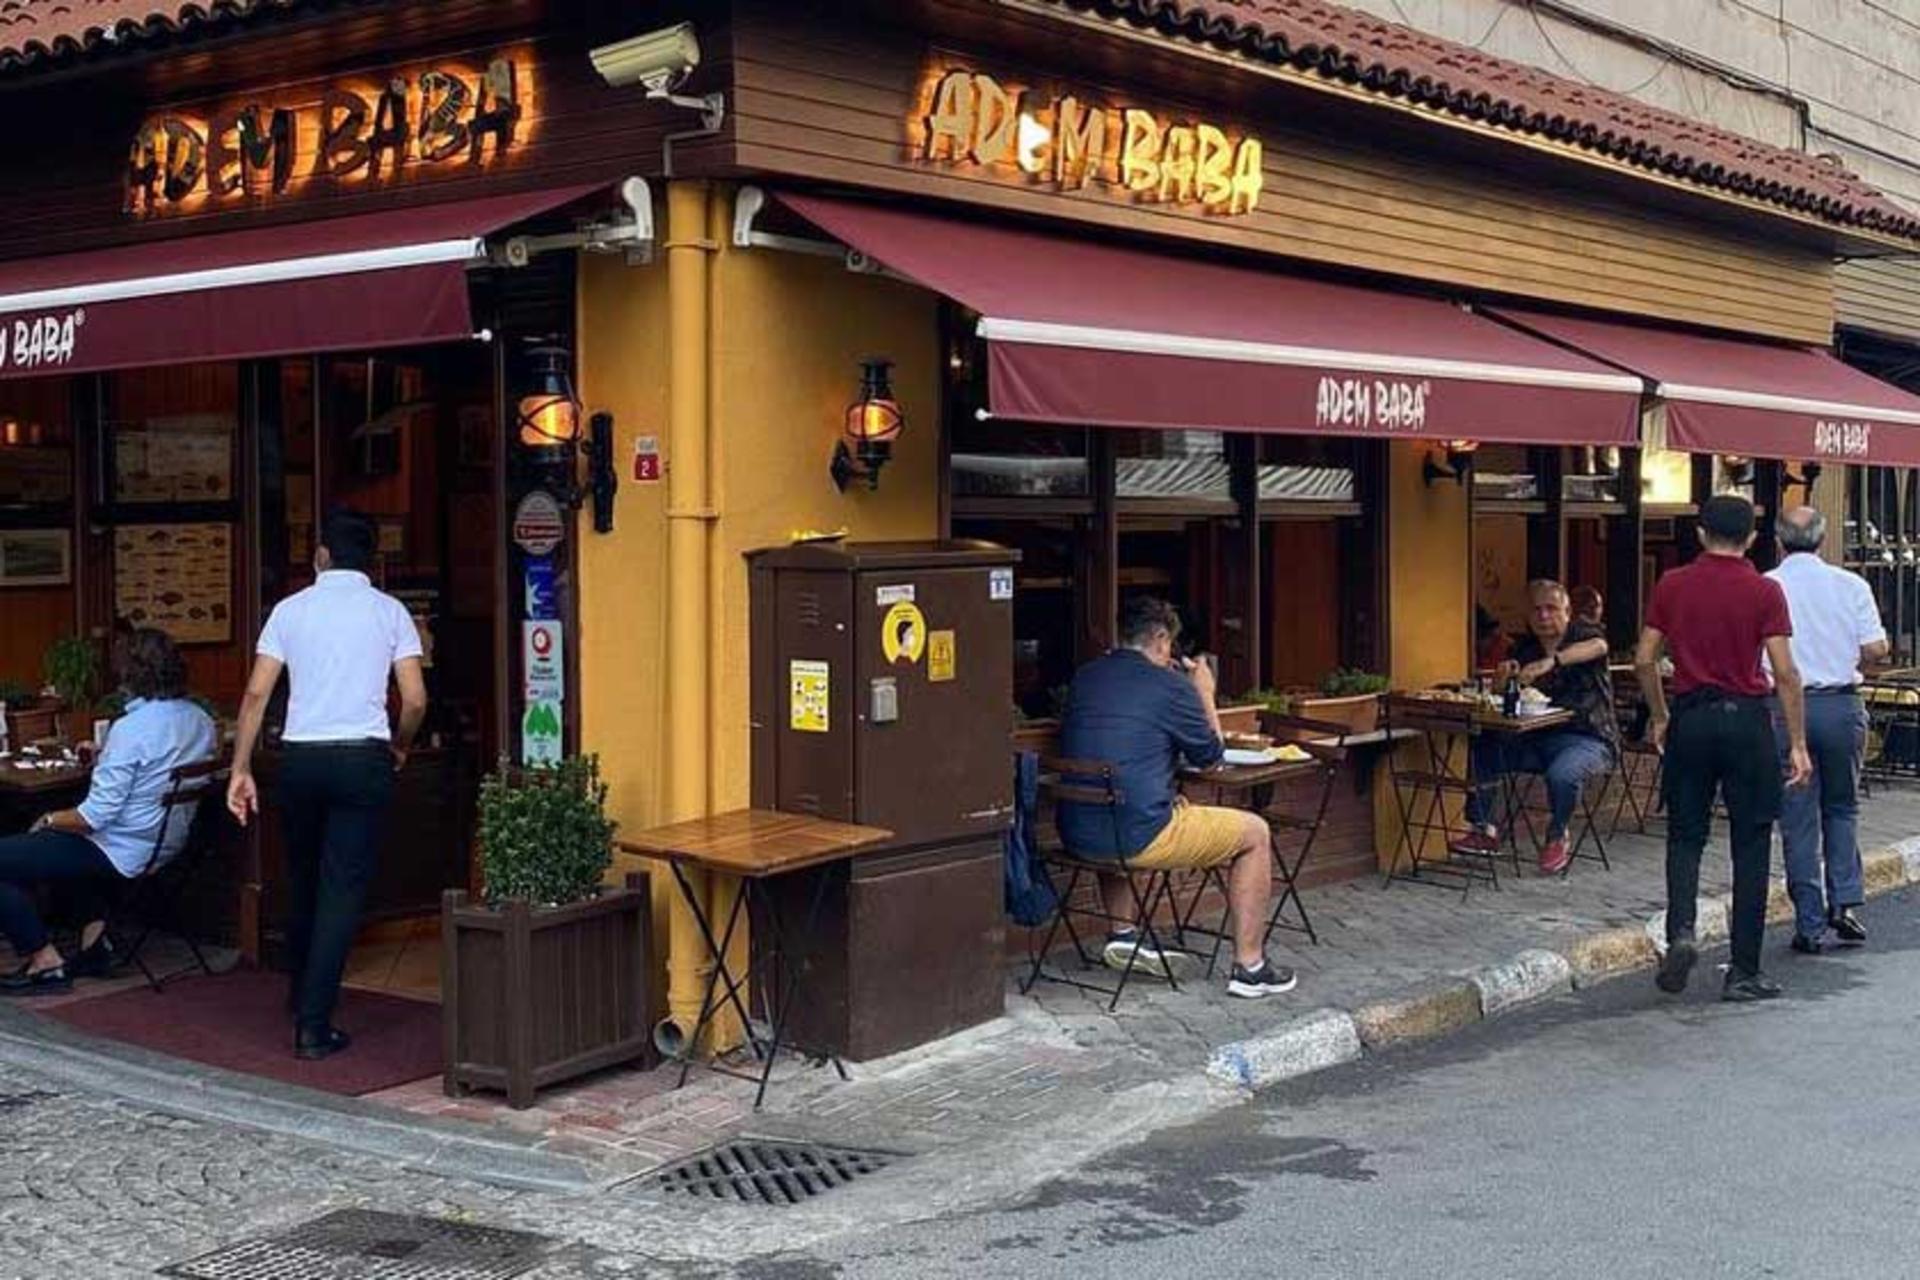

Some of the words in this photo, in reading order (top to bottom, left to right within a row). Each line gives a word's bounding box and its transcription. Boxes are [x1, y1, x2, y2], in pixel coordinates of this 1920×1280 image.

[123, 103, 297, 215] ADEM
[319, 58, 521, 184] BABA
[923, 68, 1107, 192] ADEM
[1120, 108, 1264, 216] BABA
[1315, 376, 1371, 429] ADEM
[1374, 380, 1425, 431] BABA
[1814, 420, 1841, 457] ADEM
